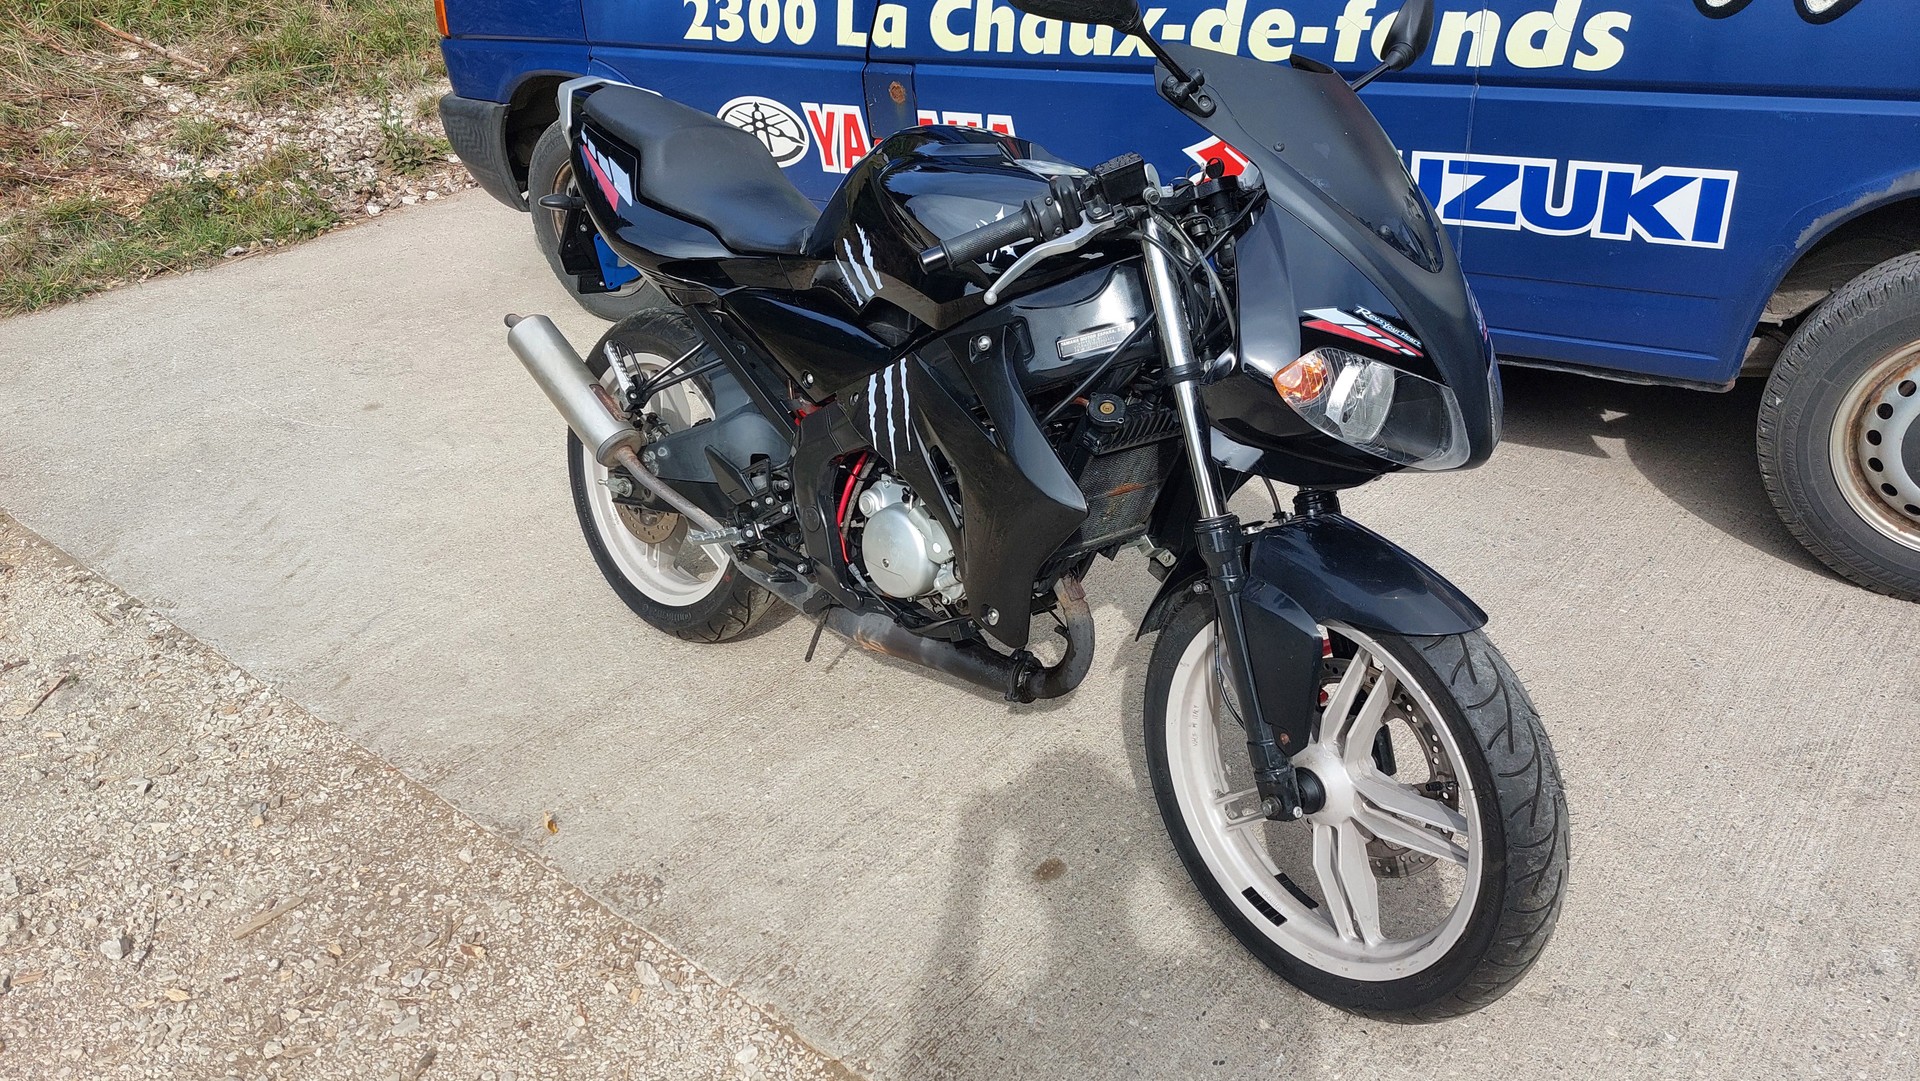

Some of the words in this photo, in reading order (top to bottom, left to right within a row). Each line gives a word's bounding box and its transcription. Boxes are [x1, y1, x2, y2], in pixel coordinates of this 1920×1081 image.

[683, 0, 817, 45] 2300
[836, 0, 908, 49] La
[1411, 151, 1738, 249] ZUKI
